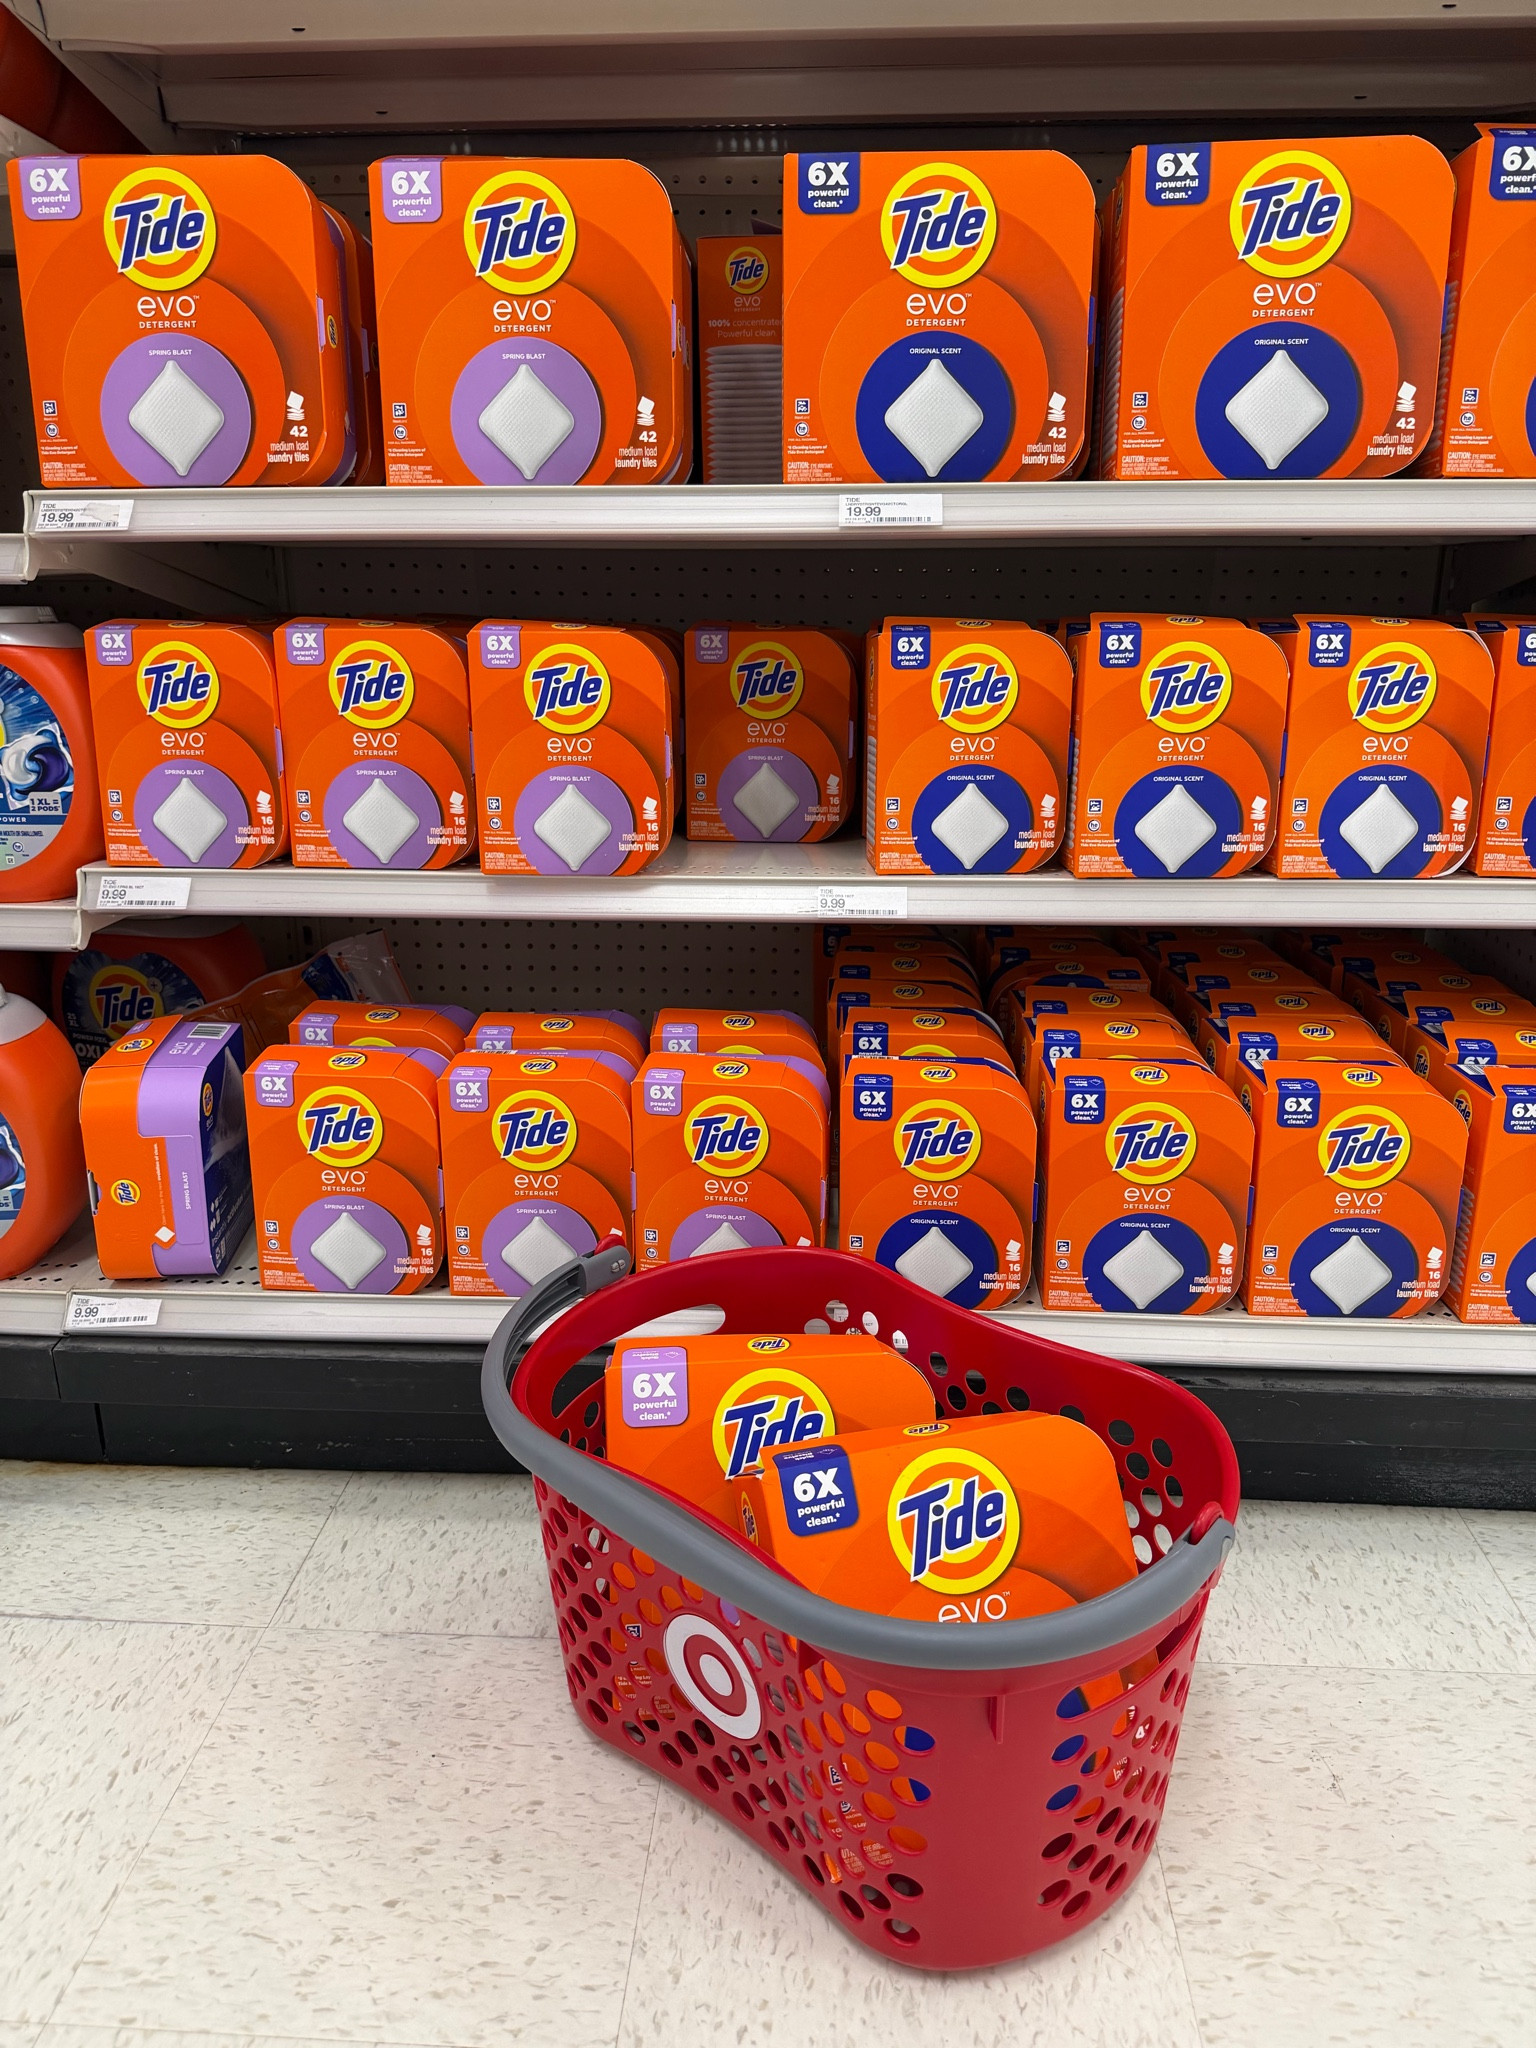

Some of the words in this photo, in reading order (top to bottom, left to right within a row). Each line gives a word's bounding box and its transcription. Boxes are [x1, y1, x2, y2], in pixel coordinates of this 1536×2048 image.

[1157, 153, 1199, 177] 6X
[30, 168, 69, 192] 6X
[808, 162, 849, 186] 6X
[392, 171, 431, 195] 6X
[1156, 179, 1198, 190] powerful
[32, 194, 70, 204] powerful
[808, 188, 849, 198] powerful
[393, 197, 431, 207] powerful
[1239, 179, 1342, 259] Tide
[112, 195, 206, 272] Tide
[890, 191, 987, 268] Tide
[472, 198, 566, 276] Tide
[729, 257, 765, 287] Tide
[1253, 309, 1314, 317] DETERGENT
[1396, 418, 1415, 429] 42
[290, 426, 308, 437] 42
[639, 431, 656, 442] 42
[1049, 427, 1066, 438] 42
[1373, 434, 1399, 444] medium
[1401, 433, 1414, 443] load
[1027, 443, 1051, 452] medium
[1053, 443, 1066, 452] load
[1367, 445, 1395, 457] laundry
[1397, 445, 1412, 454] tiles
[1022, 454, 1048, 465] laundry
[1050, 454, 1065, 463] tiles
[42, 513, 73, 522] 19.99
[847, 507, 881, 516] 19.99
[102, 634, 125, 648] 6X
[292, 633, 317, 647] 6X
[487, 636, 513, 650] 6X
[701, 635, 722, 648] 6X
[898, 637, 923, 652] 6X
[1107, 635, 1134, 650] 6X
[1317, 634, 1344, 649] 6X
[142, 661, 211, 714] Tide
[335, 661, 406, 714] Tide
[737, 661, 797, 707] Tide
[1147, 662, 1225, 719] Tide
[1353, 663, 1431, 718] Tide
[531, 664, 603, 719] Tide
[939, 664, 1011, 719] Tide
[262, 816, 273, 824] 16
[454, 817, 465, 825] 16
[647, 823, 658, 831] 16
[1044, 820, 1055, 828] 16
[1254, 823, 1265, 831] 16
[1454, 823, 1465, 832] 16
[821, 899, 845, 908] 9.99
[96, 986, 155, 1030] Tide
[261, 1077, 286, 1091] 6X
[456, 1082, 481, 1096] 6X
[650, 1085, 675, 1099] 6X
[860, 1091, 886, 1105] 6X
[1072, 1094, 1098, 1108] 6X
[1285, 1098, 1313, 1111] 6X
[304, 1105, 375, 1153] Tide
[499, 1110, 569, 1158] Tide
[691, 1116, 761, 1162] Tide
[901, 1119, 974, 1167] Tide
[1113, 1122, 1189, 1170] Tide
[1325, 1125, 1404, 1175] Tide
[421, 1248, 432, 1256] 16
[1221, 1267, 1232, 1275] 16
[1429, 1271, 1440, 1279] 16
[74, 1307, 98, 1318] 9.99
[633, 1372, 676, 1398] 6X
[634, 1399, 677, 1411] powerful
[722, 1396, 824, 1480] Tide
[794, 1468, 842, 1502] 6X
[798, 1498, 845, 1517] powerful
[896, 1476, 1006, 1581] Tide
